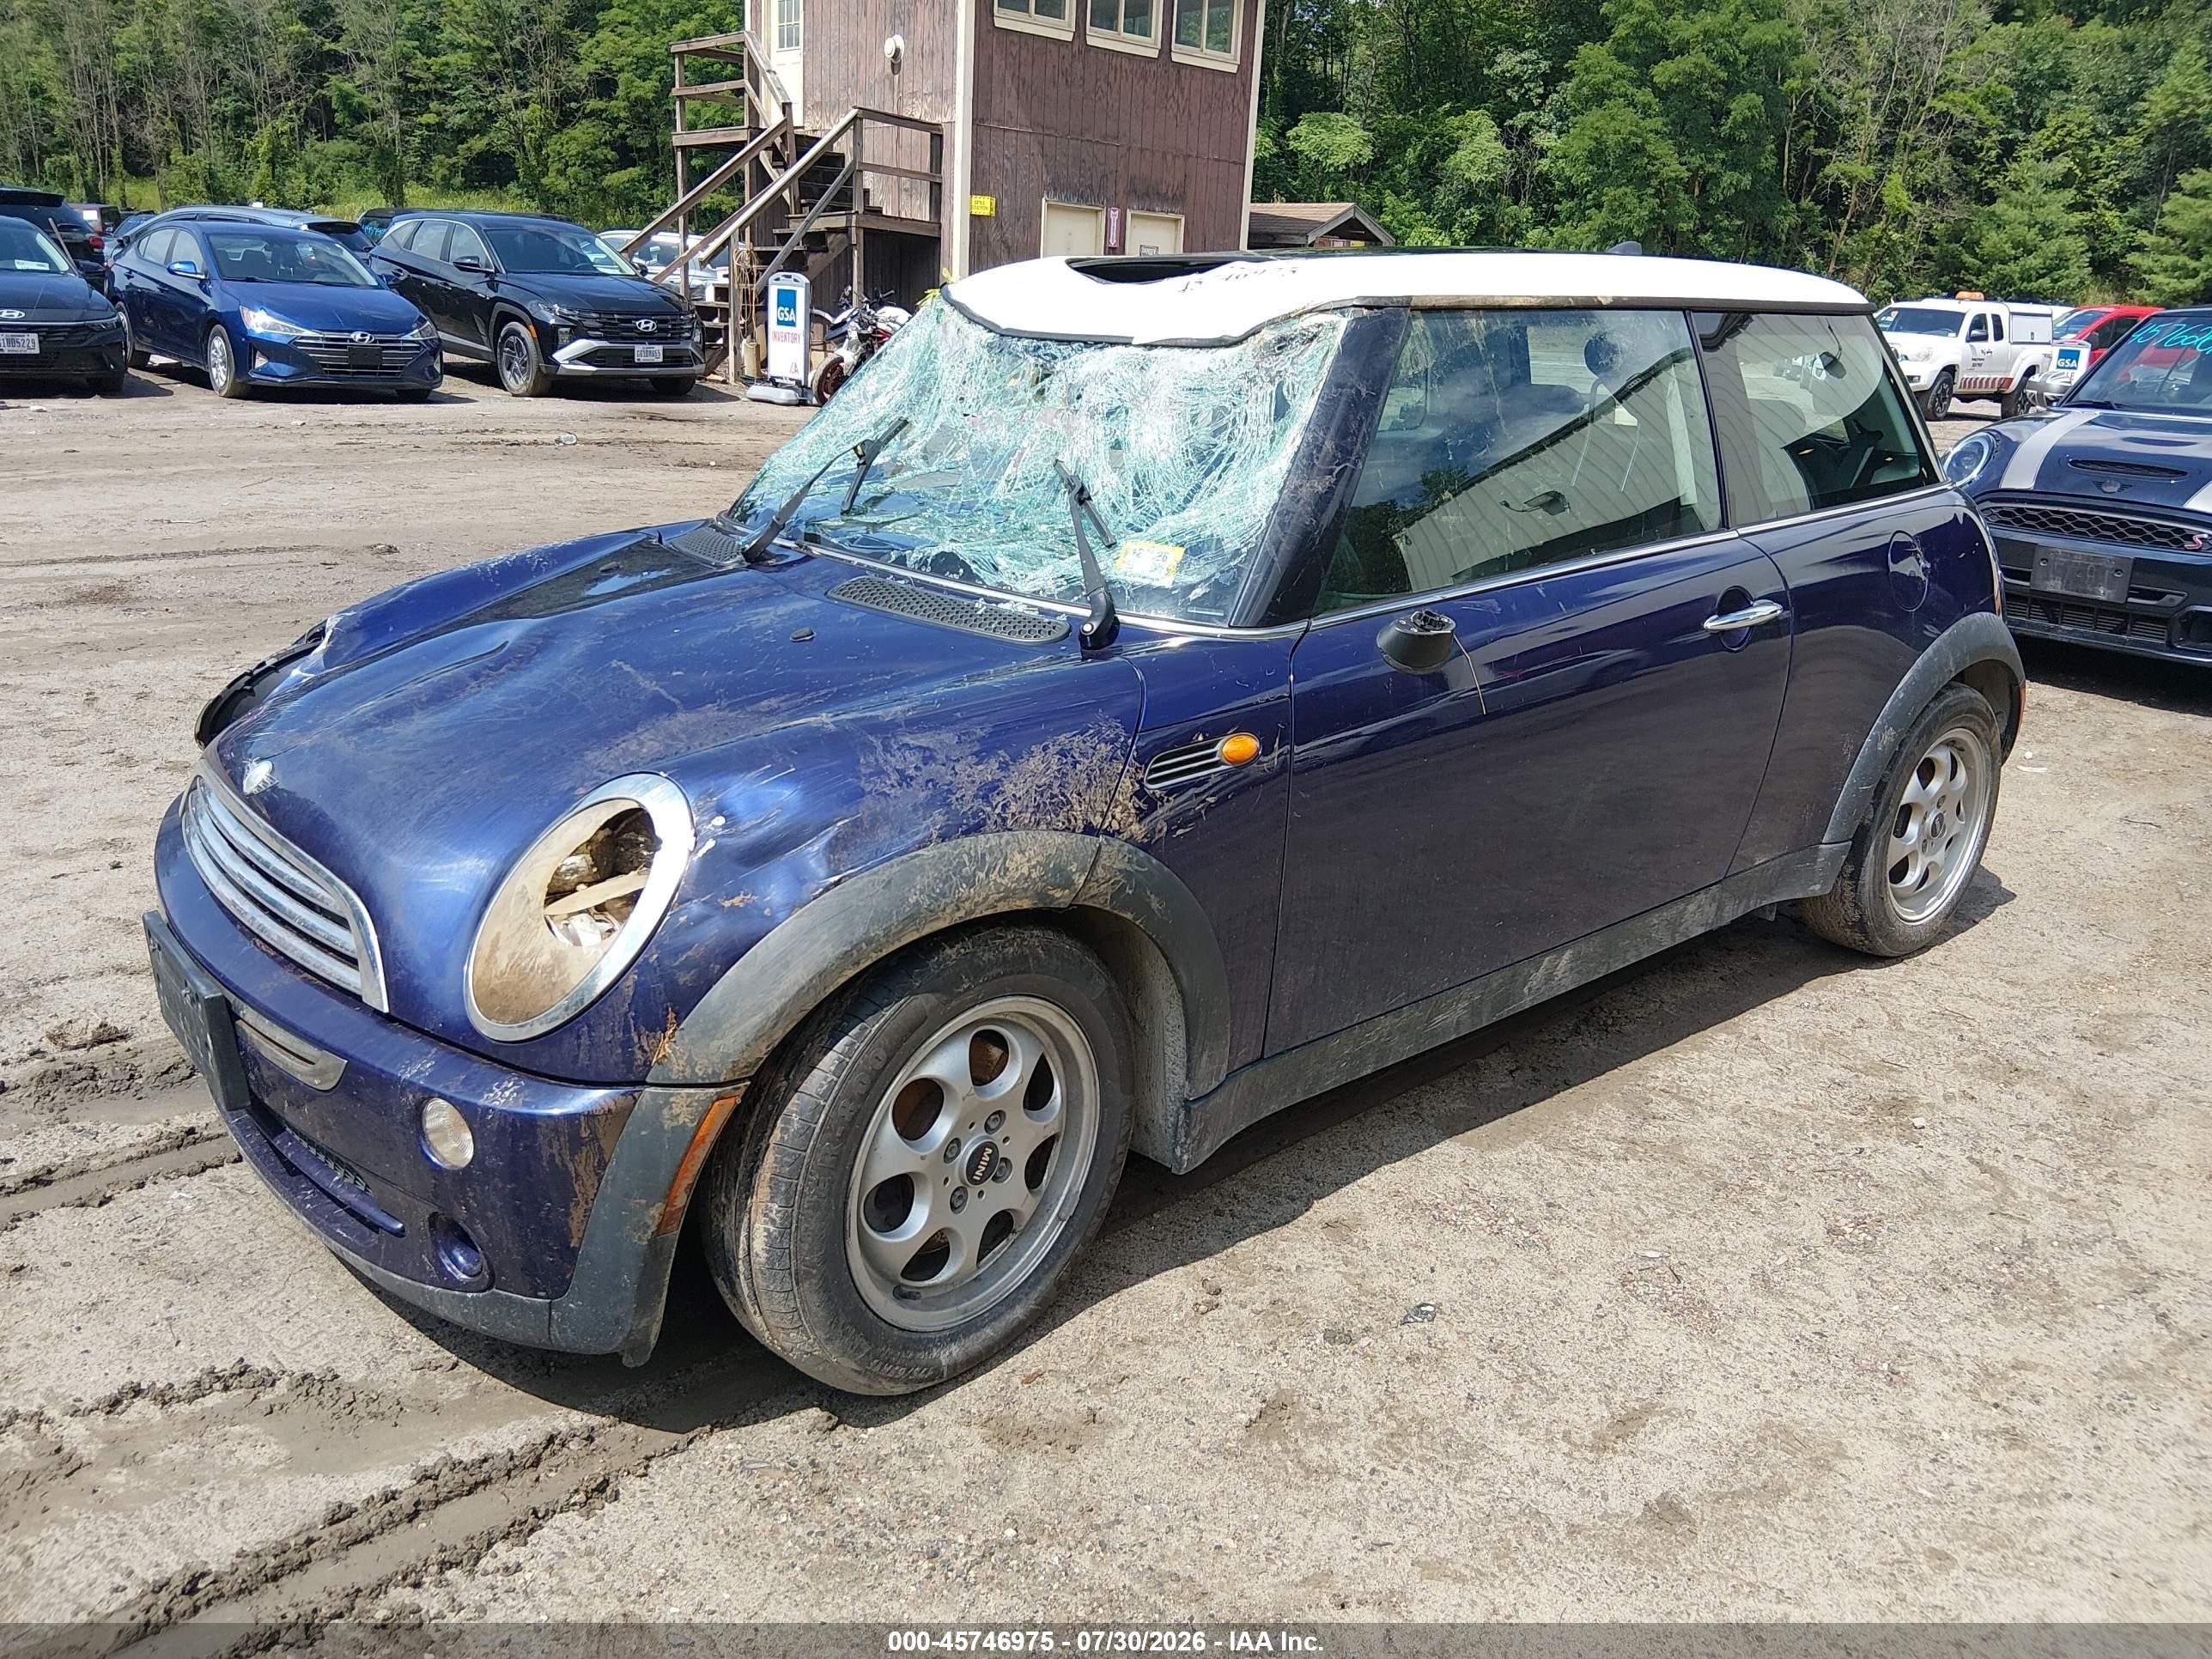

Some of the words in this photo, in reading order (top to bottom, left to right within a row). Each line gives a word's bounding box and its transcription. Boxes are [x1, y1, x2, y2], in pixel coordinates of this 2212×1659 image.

[777, 307, 796, 323] GSA
[772, 331, 801, 343] INVENTORY
[2057, 358, 2077, 368] GSA
[973, 1147, 993, 1181] MINI
